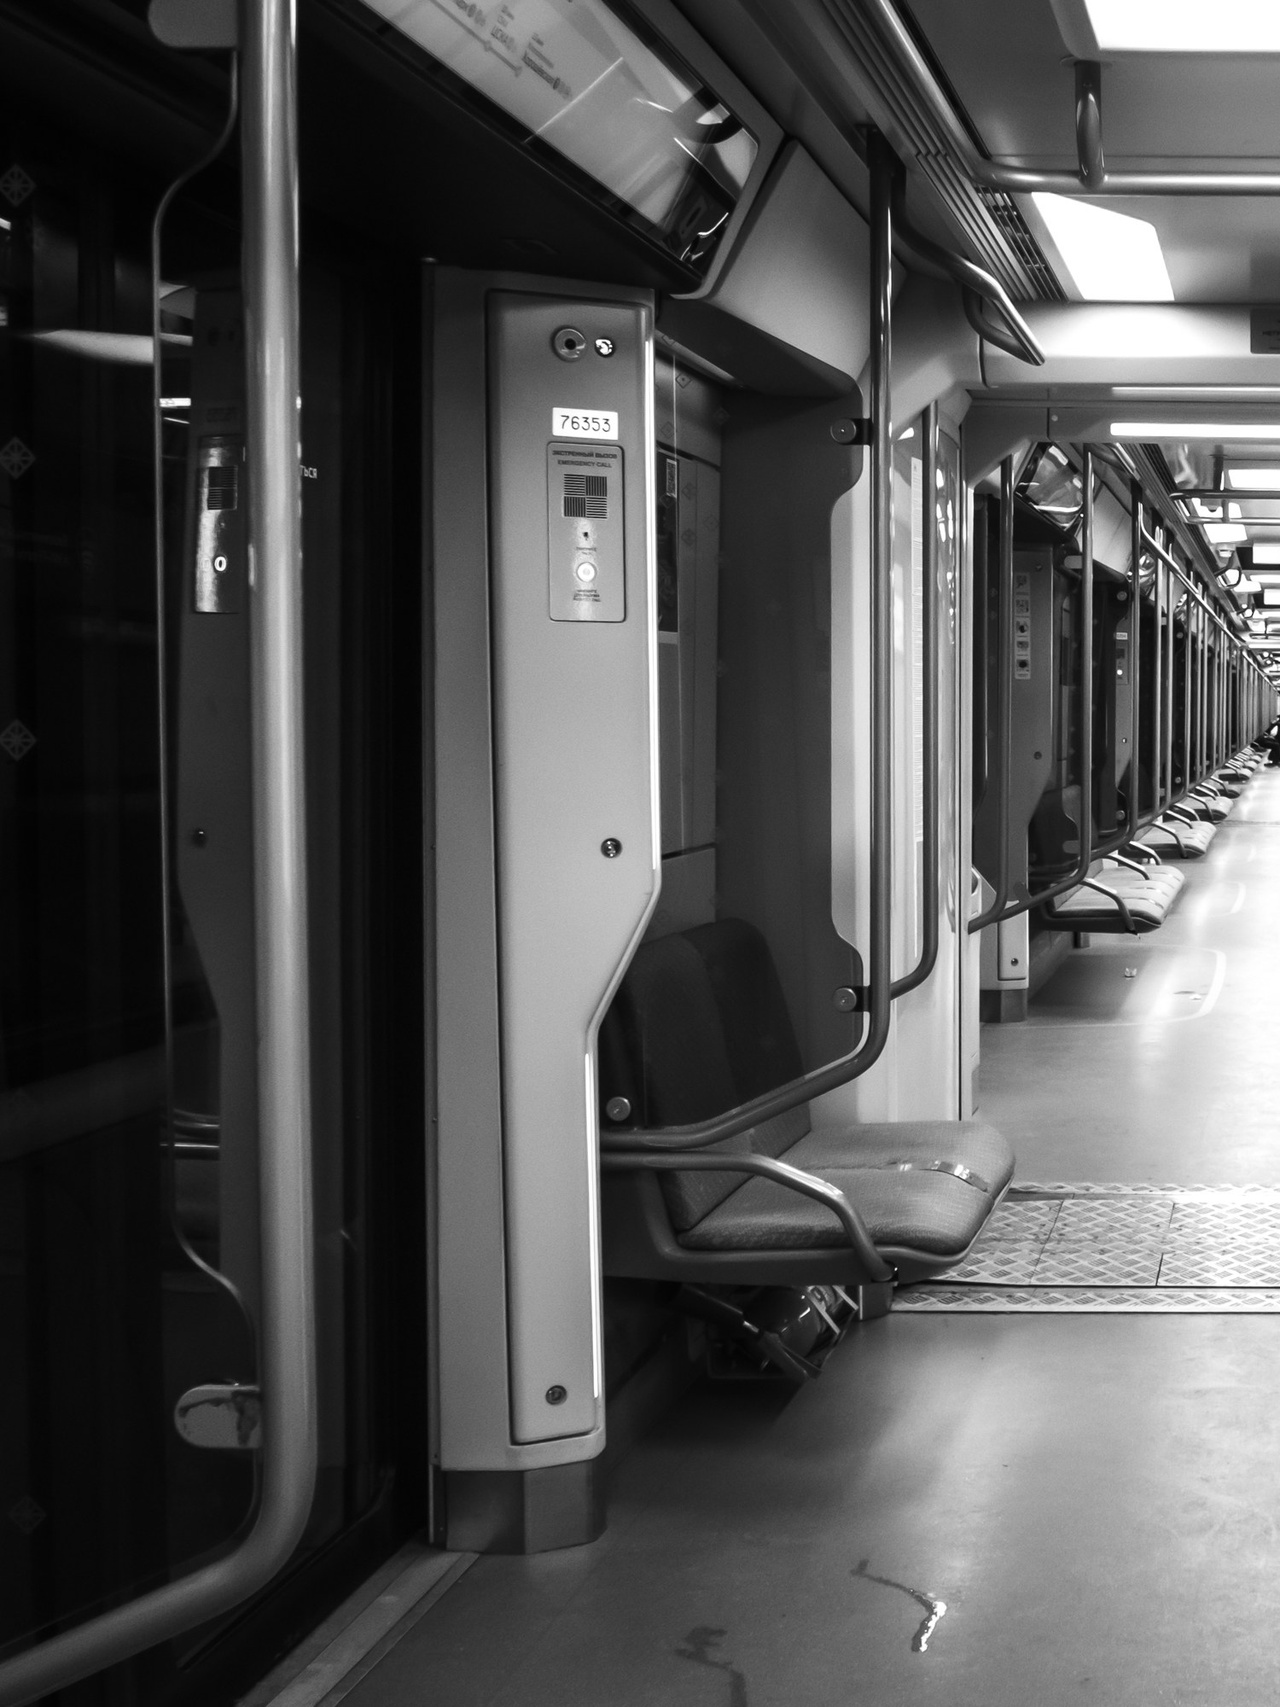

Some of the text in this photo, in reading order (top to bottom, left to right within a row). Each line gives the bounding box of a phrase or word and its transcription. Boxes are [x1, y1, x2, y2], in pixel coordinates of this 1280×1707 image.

[560, 414, 611, 433] 76353
[552, 450, 618, 460] ЭКСТРЕННЫЙ ВЫЗОВ
[557, 459, 595, 467] EMERGENCY
